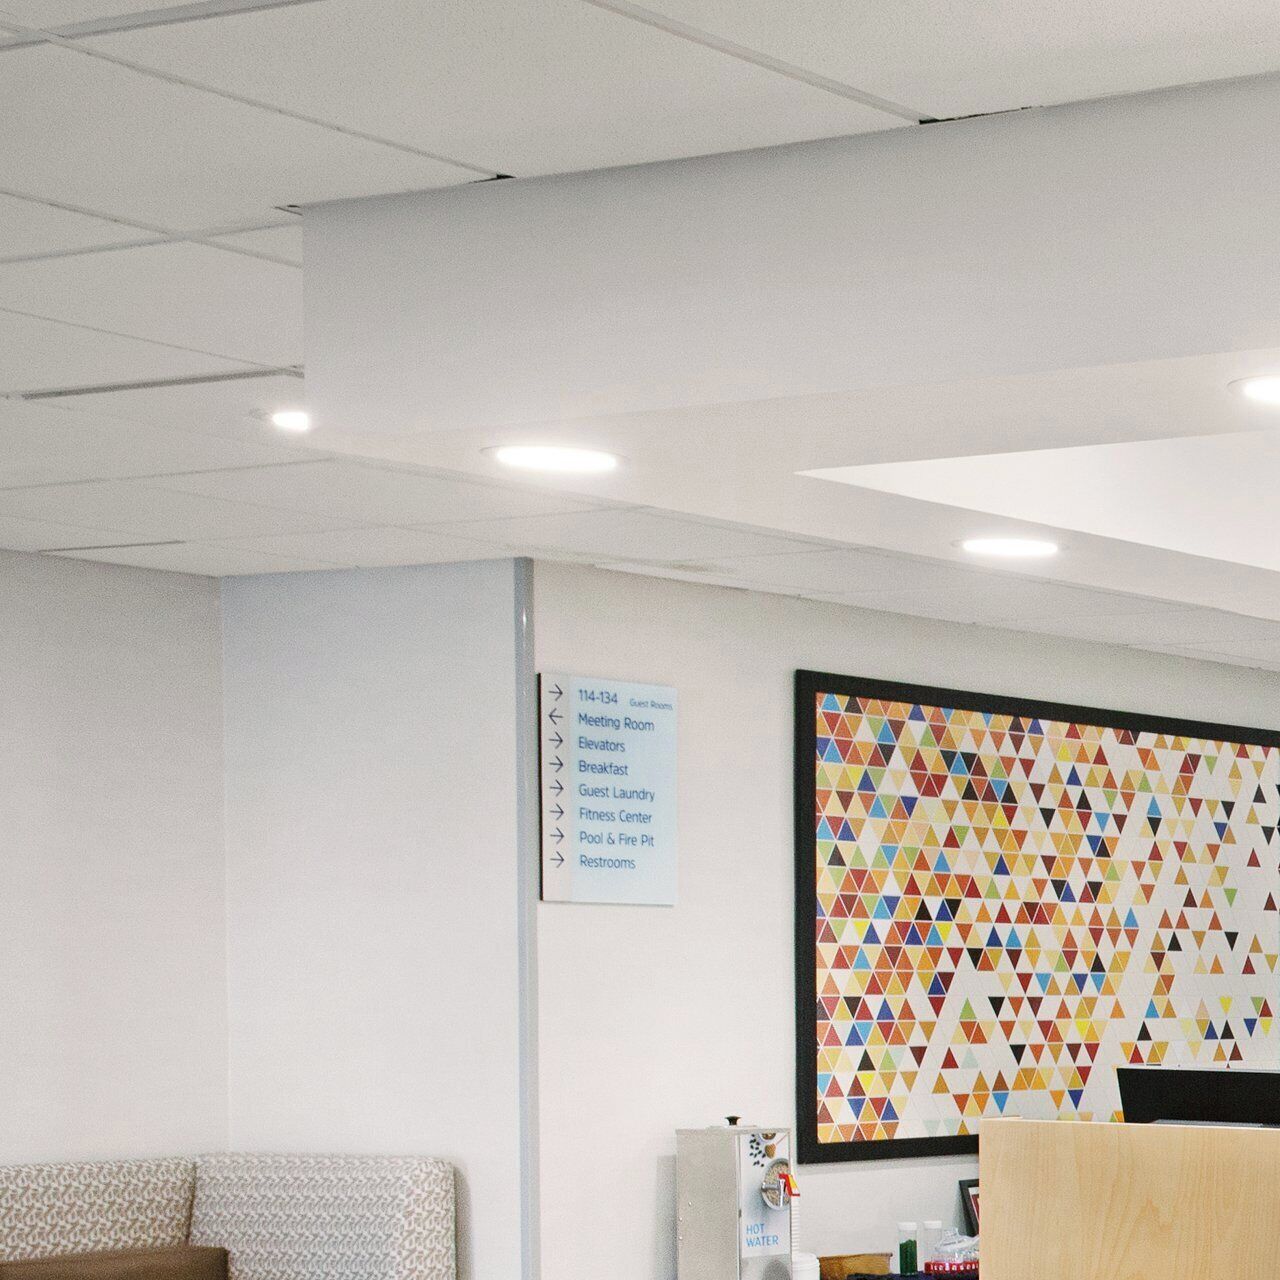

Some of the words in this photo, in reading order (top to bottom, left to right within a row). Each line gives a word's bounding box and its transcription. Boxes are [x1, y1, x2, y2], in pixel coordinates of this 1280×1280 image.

[578, 689, 618, 704] 114-134
[629, 699, 648, 708] Guest
[650, 701, 673, 710] Rooms
[578, 713, 620, 730] Meeting
[624, 717, 655, 731] Room
[578, 736, 625, 752] Elevators
[578, 760, 628, 775] Breakfast
[579, 784, 610, 798] Guest
[613, 787, 655, 802] Laundry
[579, 807, 615, 821] Fitness
[619, 810, 652, 823] Center
[580, 831, 603, 845] Pool
[607, 832, 615, 845] &
[619, 833, 637, 846] Fire
[641, 834, 654, 847] Pit
[580, 855, 636, 869] Restrooms
[746, 1223, 764, 1234] HOT
[746, 1235, 779, 1247] WATER
